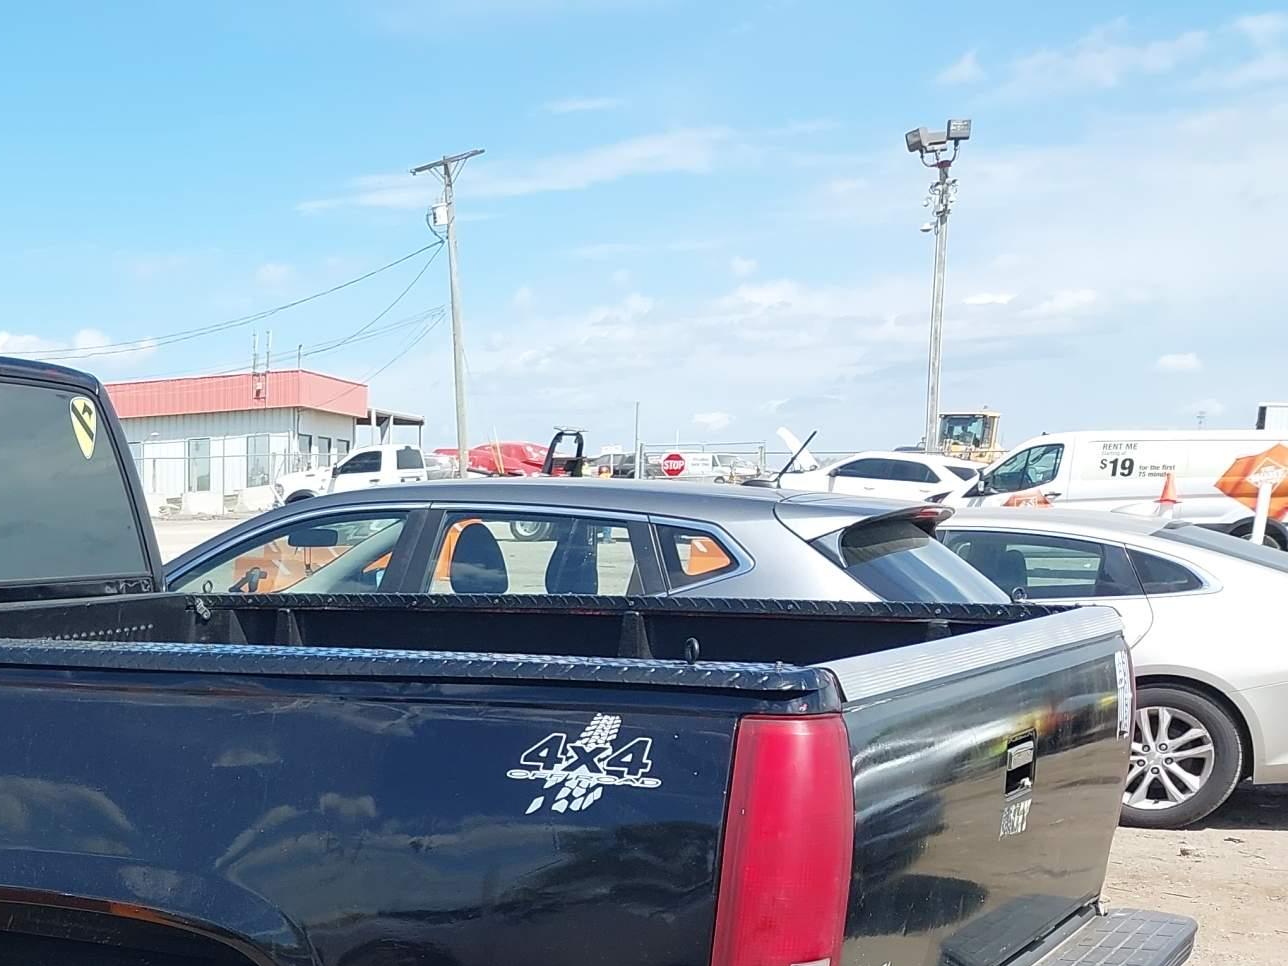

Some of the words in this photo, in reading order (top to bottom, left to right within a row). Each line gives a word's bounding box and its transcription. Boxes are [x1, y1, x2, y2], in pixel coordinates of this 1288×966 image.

[1102, 443, 1123, 451] RENT
[1125, 443, 1139, 451] ME
[663, 460, 685, 470] STOP
[1100, 457, 1135, 477] $19
